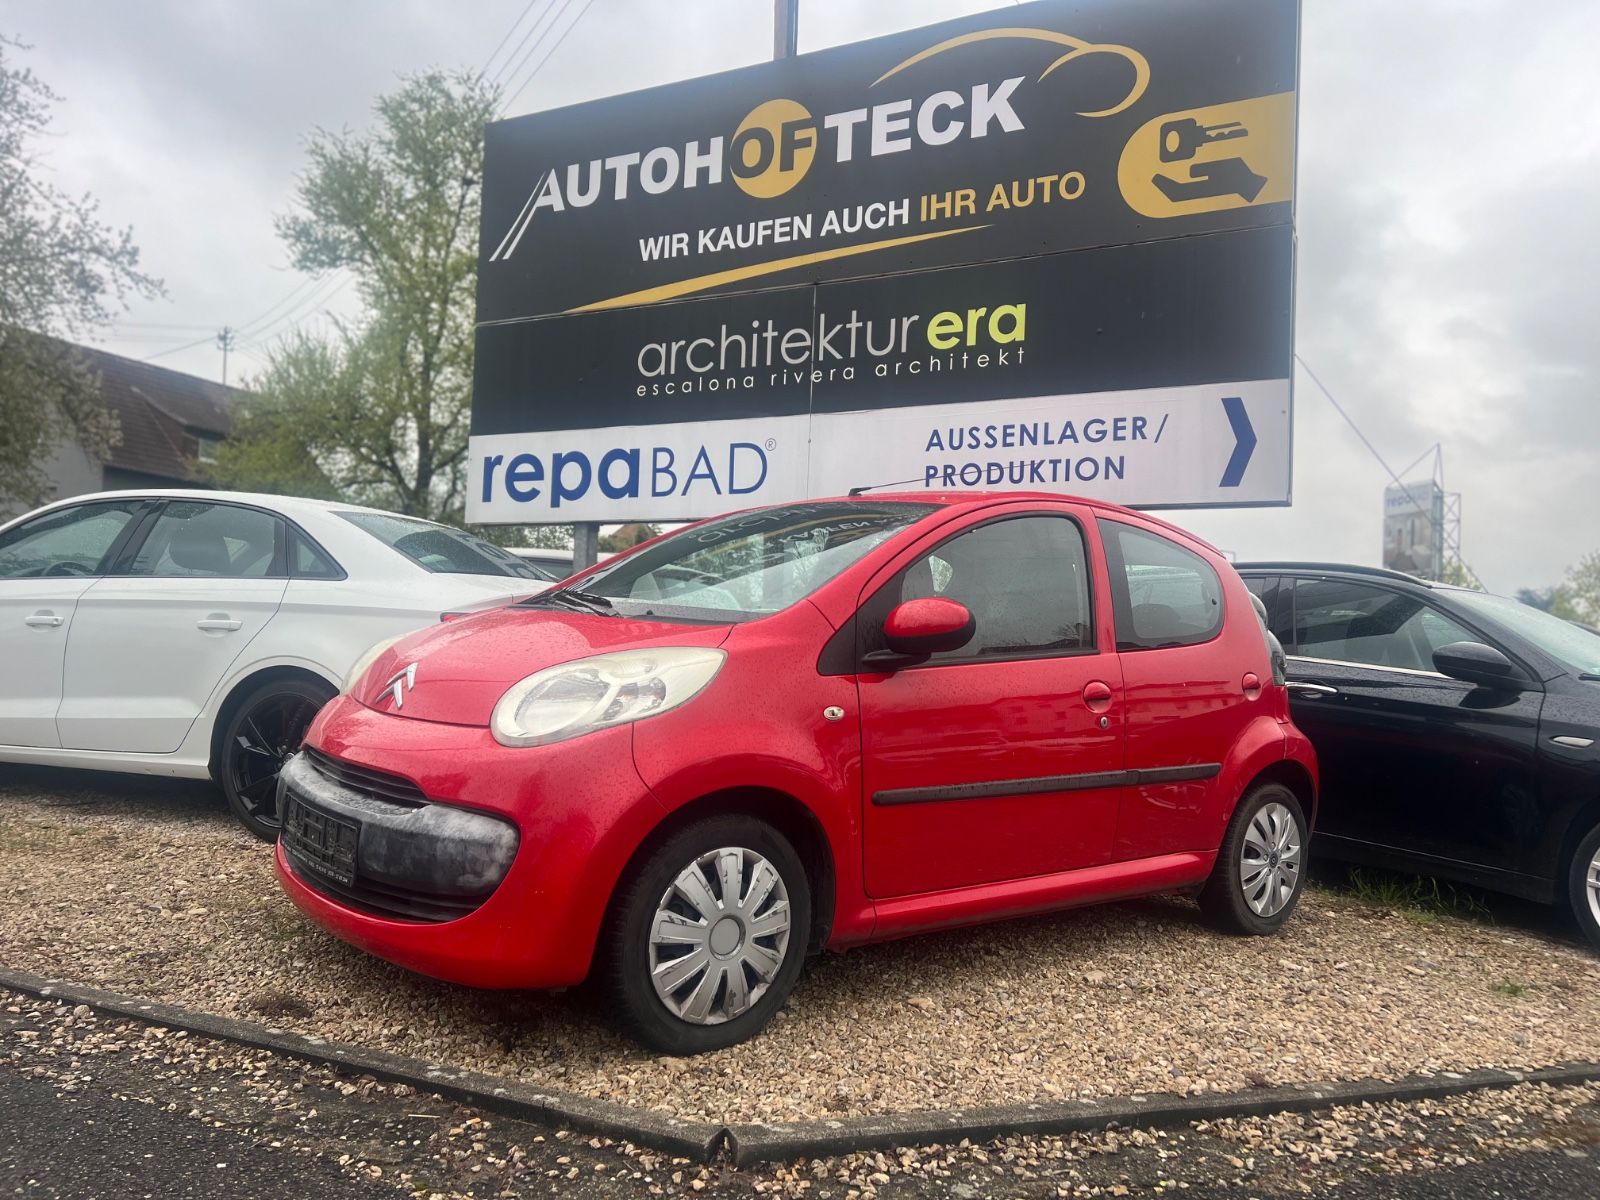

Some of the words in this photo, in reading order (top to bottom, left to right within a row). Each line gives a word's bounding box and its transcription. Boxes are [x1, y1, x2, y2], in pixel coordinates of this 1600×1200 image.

[638, 232, 689, 262] WIR
[697, 213, 812, 254] KAUFEN
[820, 198, 910, 237] AUCH
[920, 188, 976, 222] IHR
[986, 171, 1086, 212] AUTO
[636, 374, 756, 397] escalona
[770, 363, 855, 387] rivera
[874, 346, 1026, 377] architekt
[924, 455, 1125, 487] PRODUKTION
